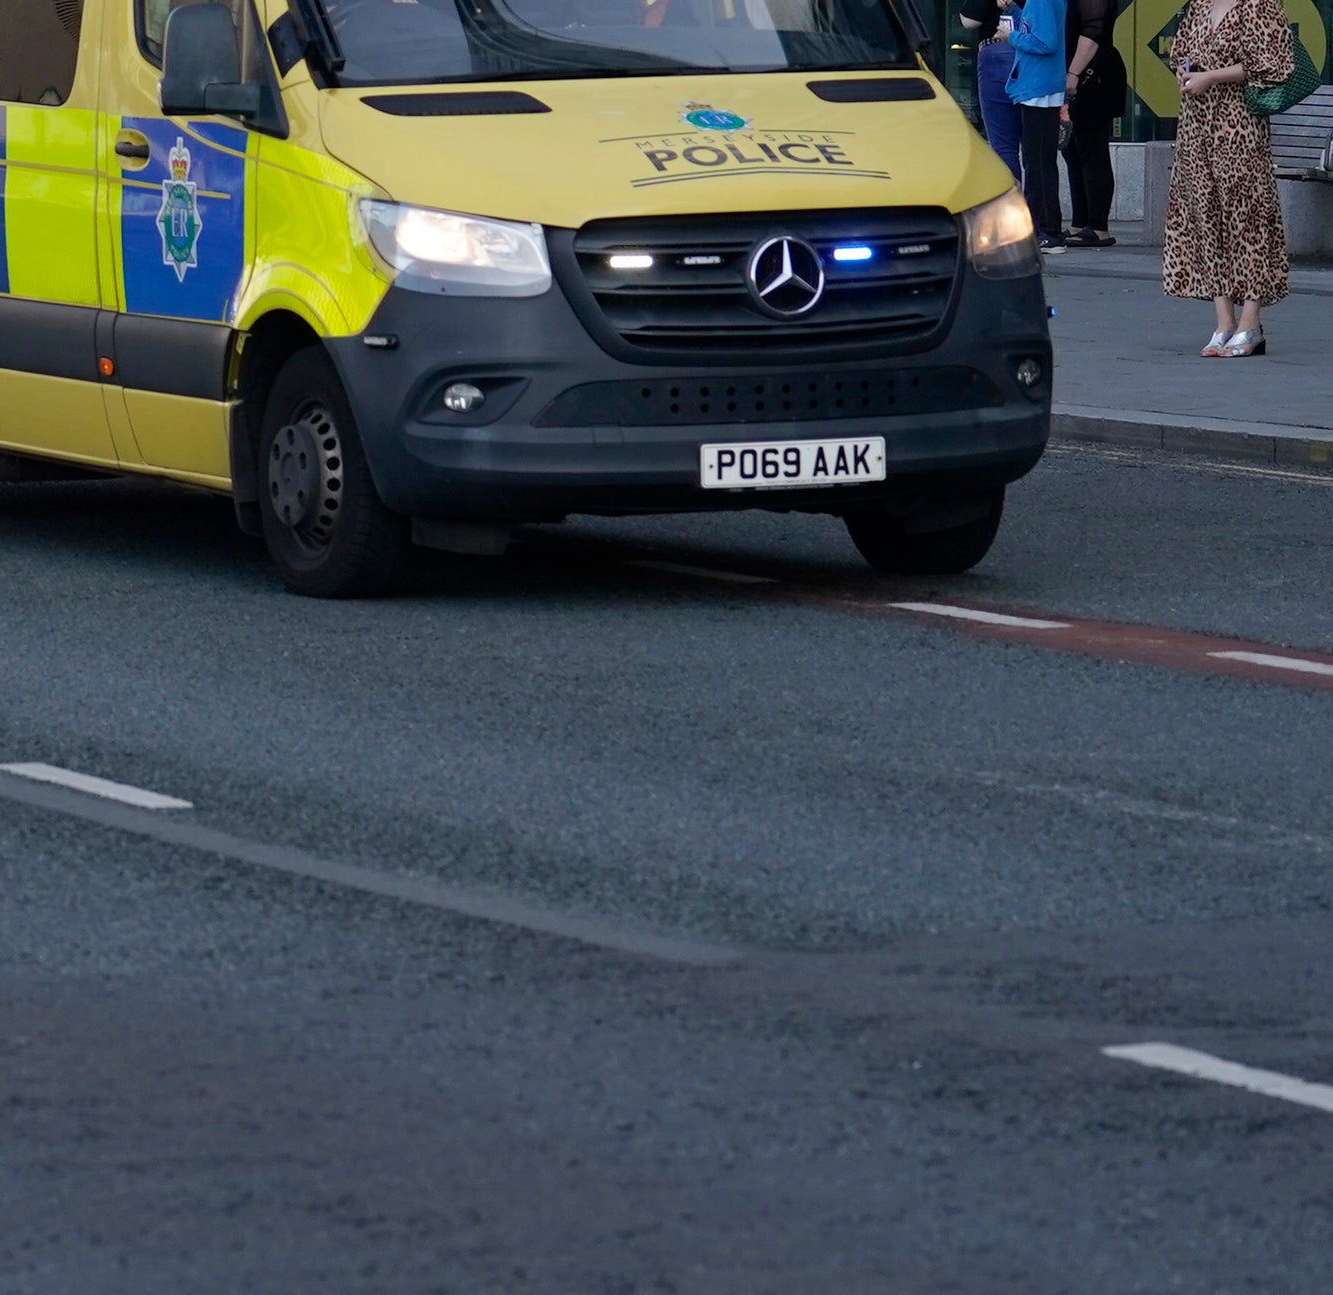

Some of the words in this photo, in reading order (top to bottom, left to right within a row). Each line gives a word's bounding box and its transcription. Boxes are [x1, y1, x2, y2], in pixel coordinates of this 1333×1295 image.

[634, 133, 837, 150] MERSEYSIDE
[643, 143, 854, 172] POLICE
[717, 447, 801, 480] PO69
[812, 443, 870, 477] AAK
